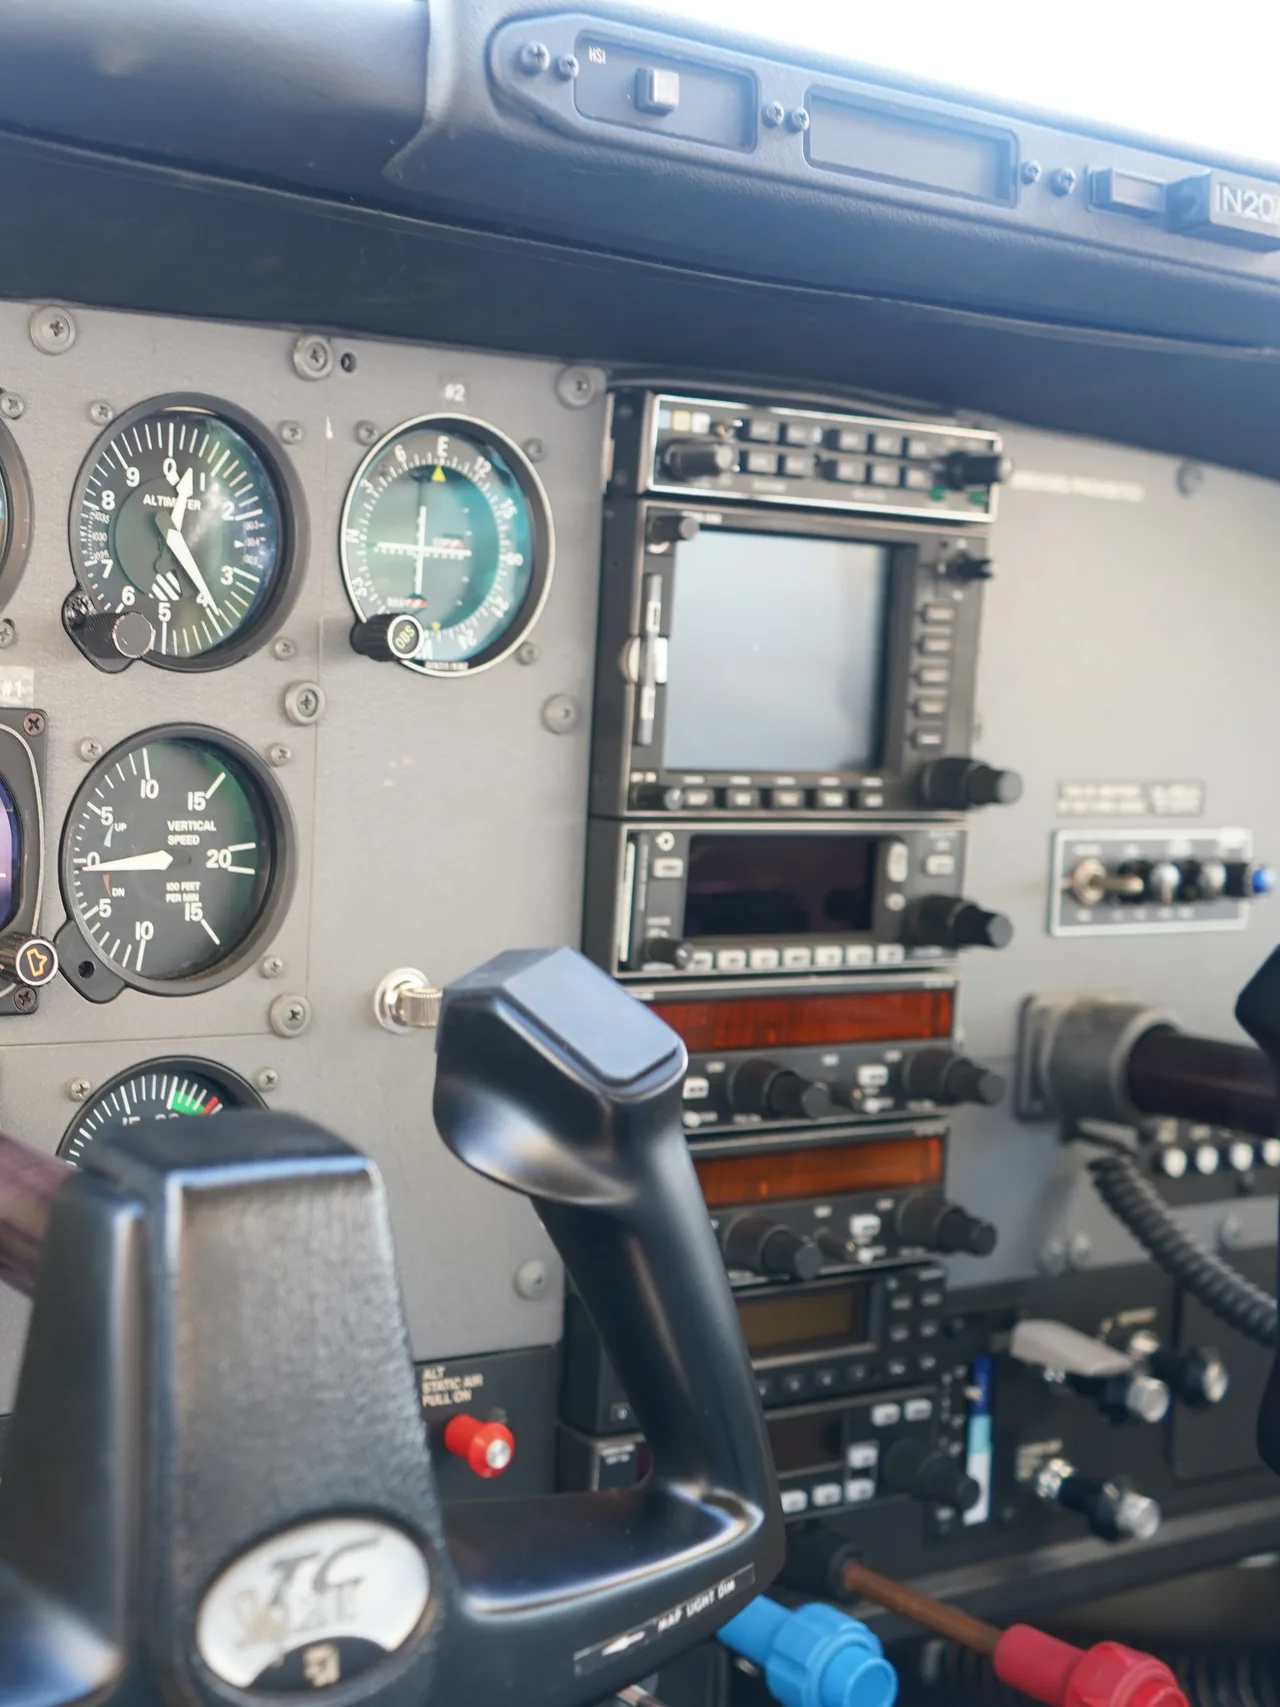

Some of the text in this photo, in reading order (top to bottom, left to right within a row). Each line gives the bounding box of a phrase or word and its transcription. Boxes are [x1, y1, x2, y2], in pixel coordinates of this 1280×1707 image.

[126, 467, 140, 487] 9
[101, 489, 115, 511] 8
[221, 565, 234, 585] 3
[122, 586, 135, 606] 6
[158, 602, 171, 622] 5
[395, 625, 415, 649] OBS
[140, 779, 159, 799] 10
[187, 792, 207, 811] 15
[100, 806, 114, 826] 5
[167, 820, 217, 832] VERTICAL
[114, 822, 127, 833] UP
[167, 834, 201, 846] SPEED
[205, 849, 232, 869] 20
[111, 887, 125, 898] DN
[98, 898, 111, 918] 5
[184, 902, 203, 921] 15
[135, 920, 154, 940] 10
